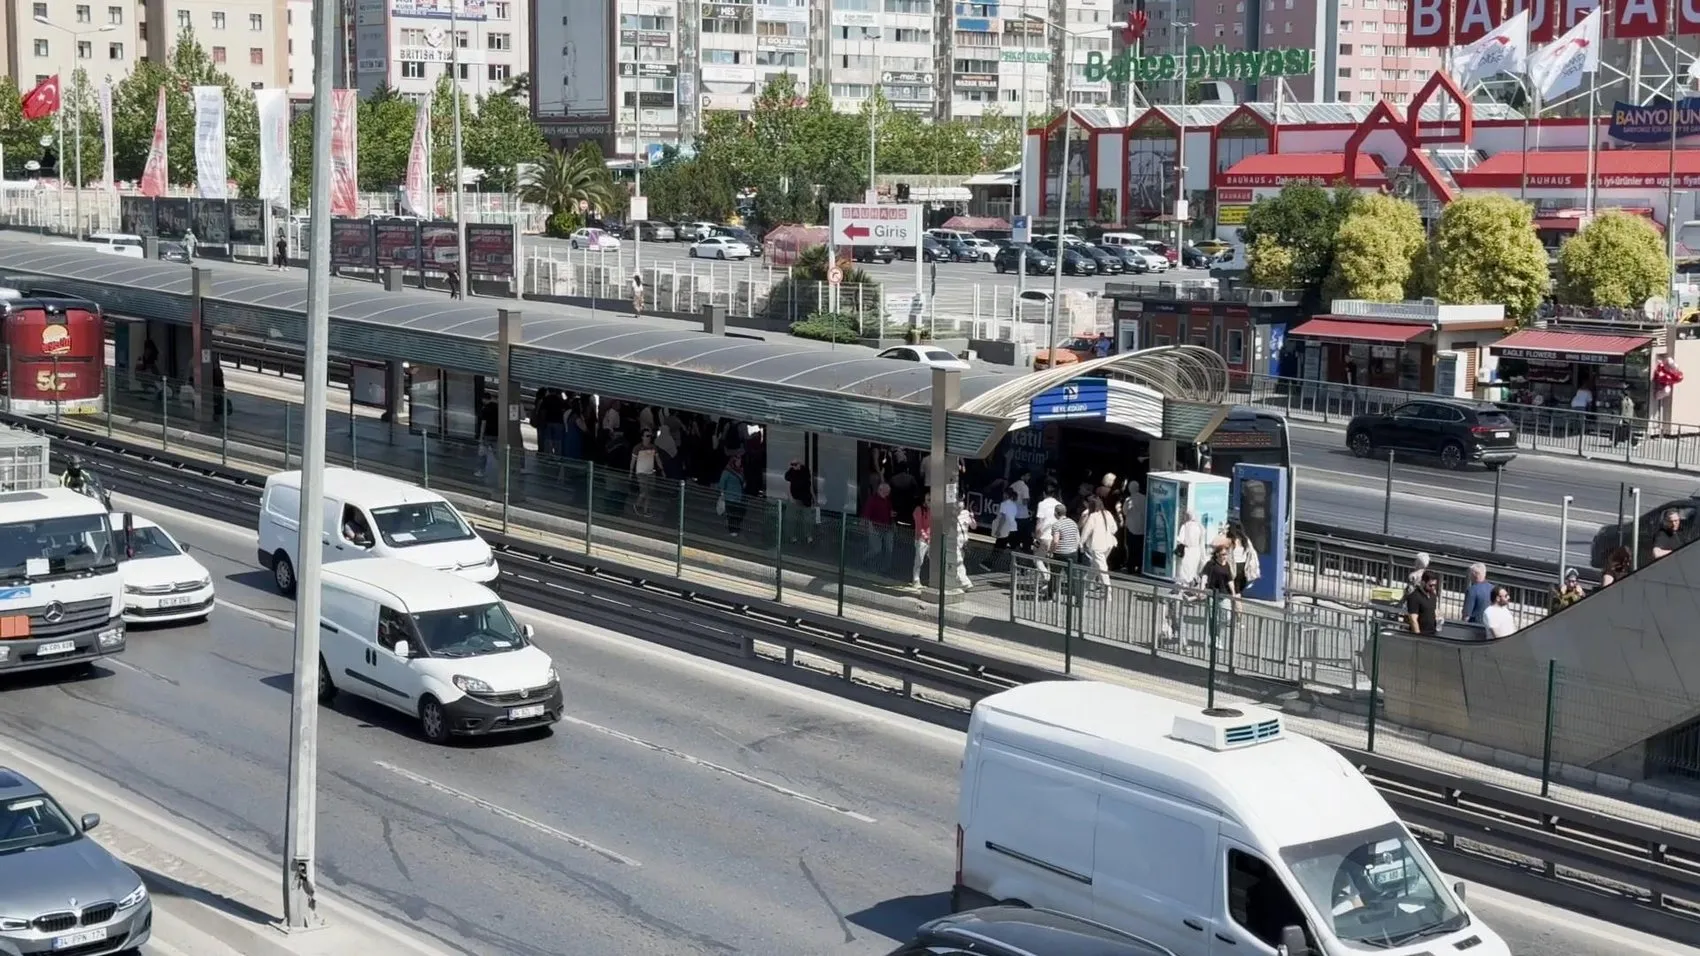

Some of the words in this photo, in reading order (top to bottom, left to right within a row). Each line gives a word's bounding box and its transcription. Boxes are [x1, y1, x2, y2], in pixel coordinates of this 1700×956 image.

[1227, 176, 1265, 184] BAUHAUS
[843, 208, 907, 219] BAUHAUS
[874, 226, 907, 239] Giriş
[1502, 349, 1523, 357] EAGLE
[1526, 350, 1557, 359] FLOWERS
